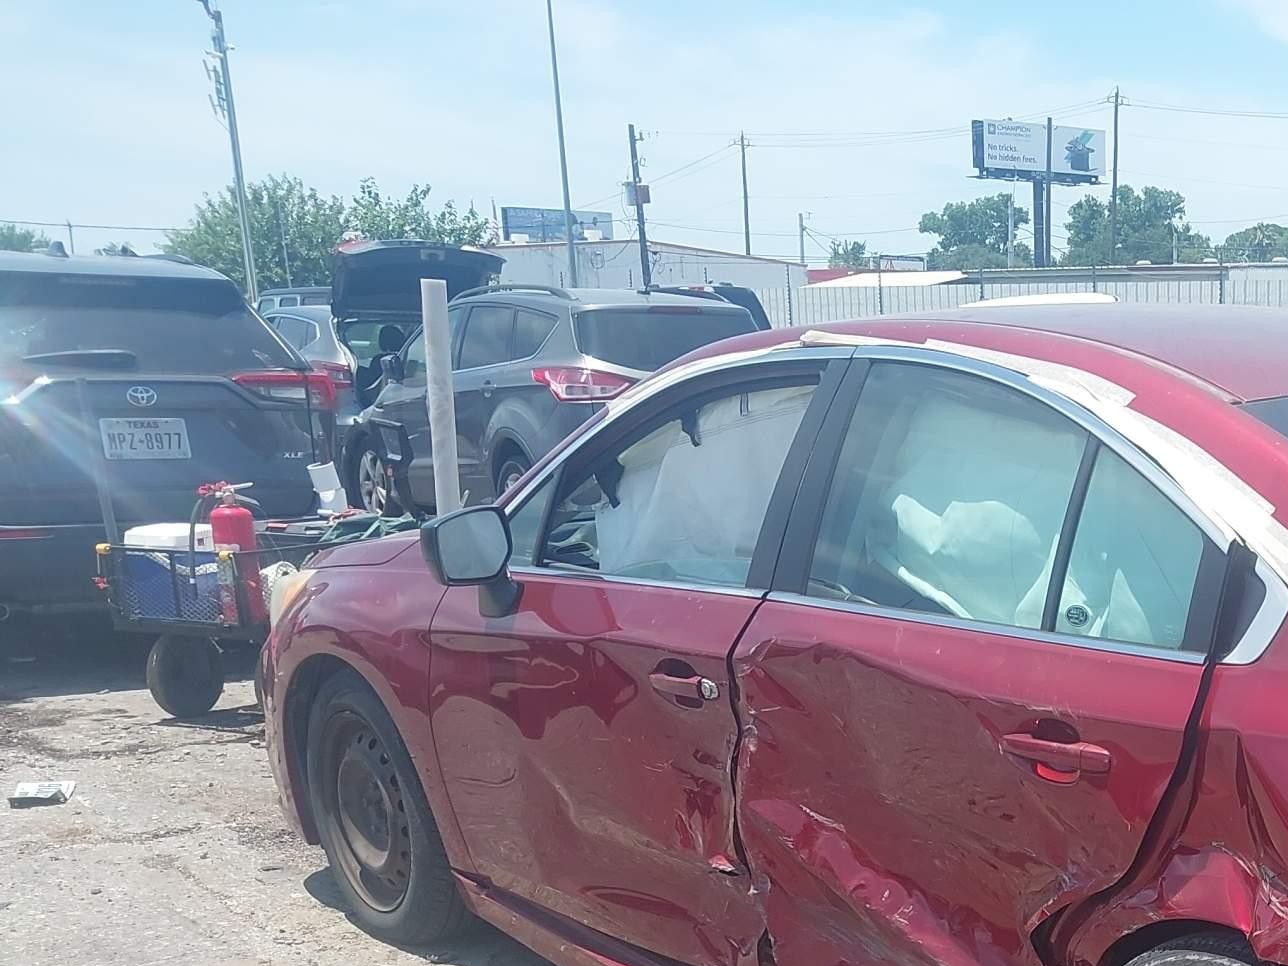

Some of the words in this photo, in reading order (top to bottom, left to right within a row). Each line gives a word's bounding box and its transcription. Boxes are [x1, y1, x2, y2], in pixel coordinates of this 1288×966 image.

[988, 143, 998, 151] No
[988, 153, 998, 161] No
[998, 153, 1021, 162] hidden
[127, 420, 160, 429] TEXAS
